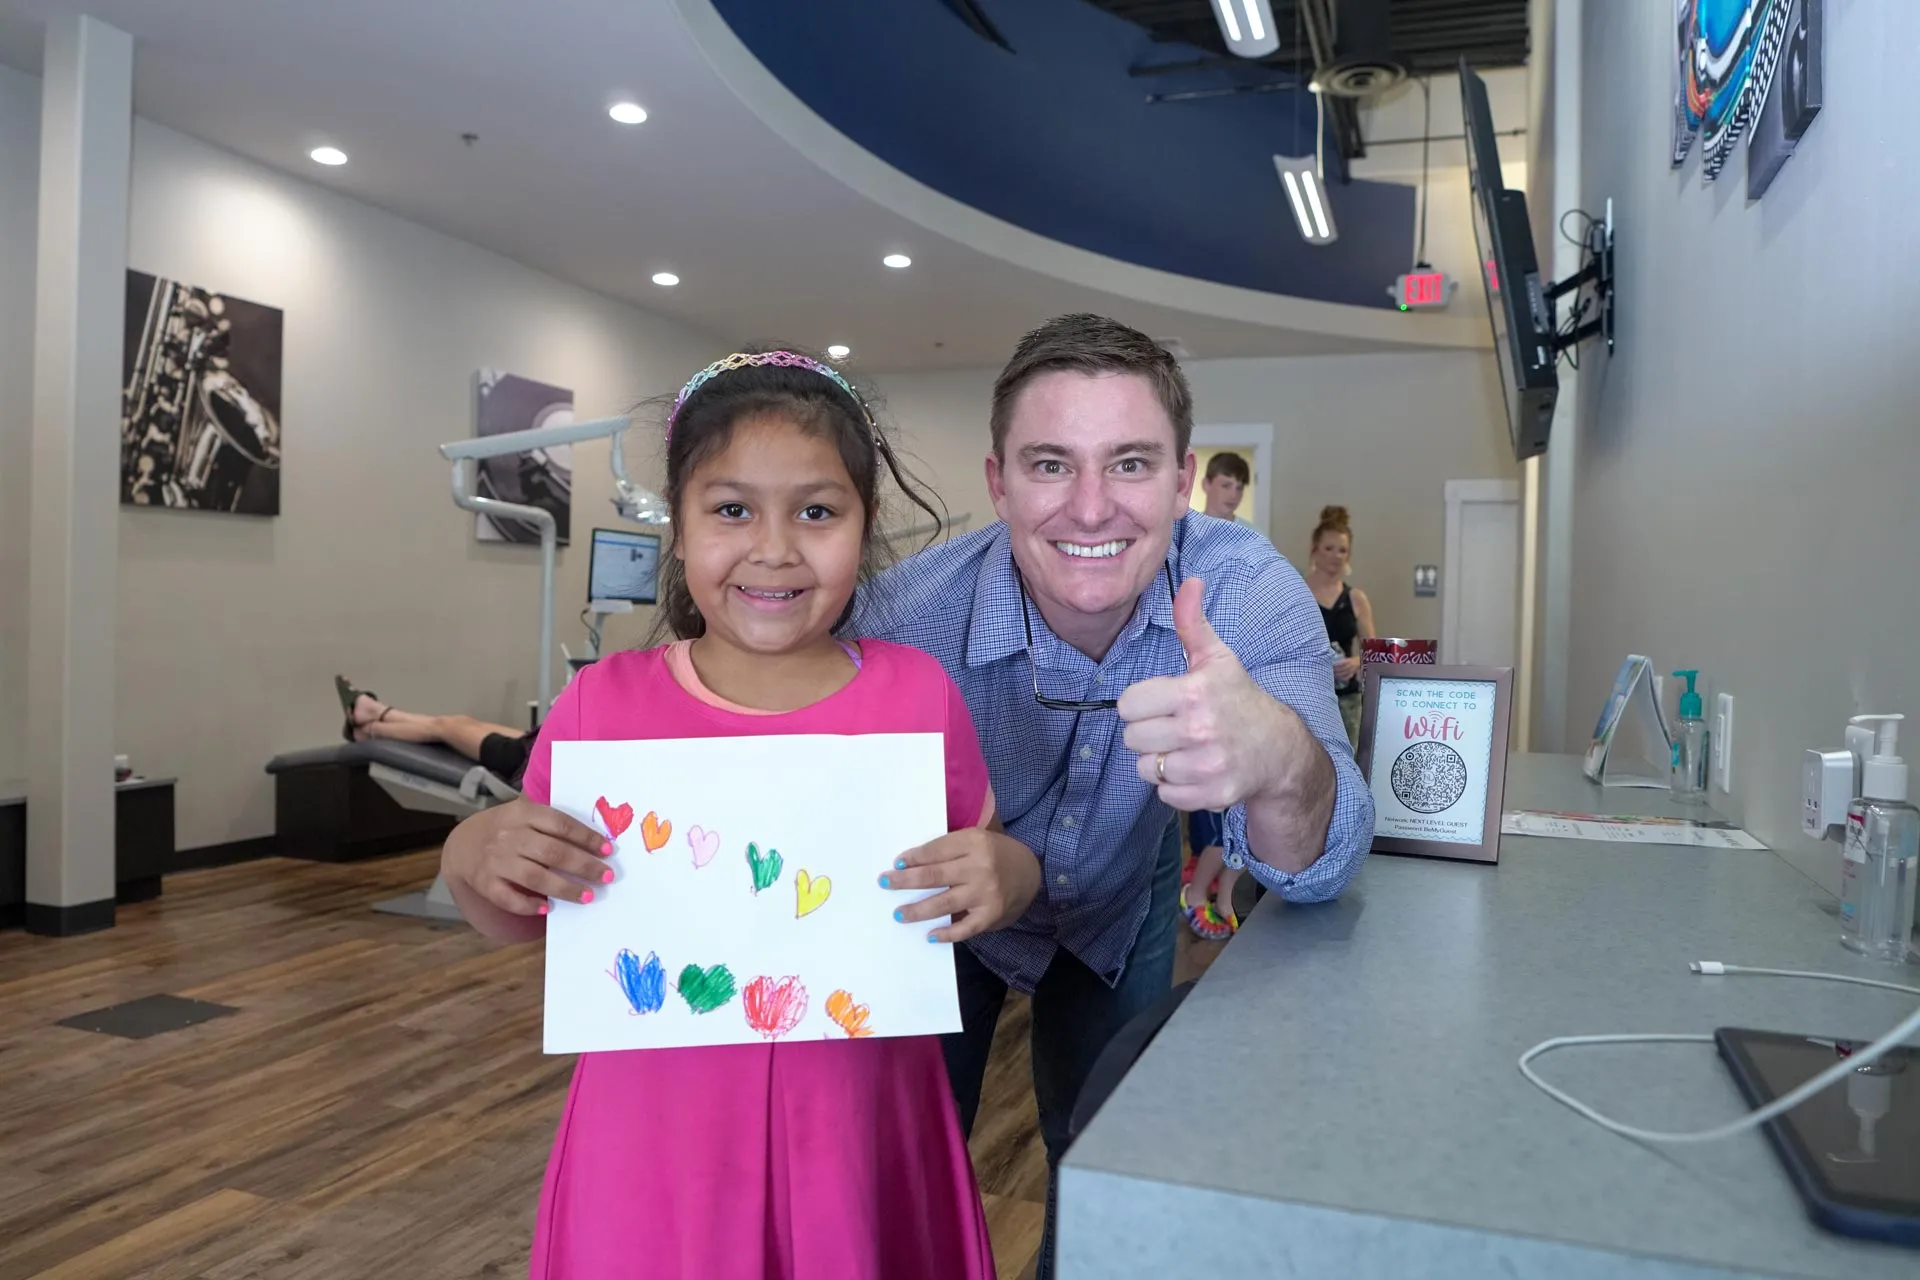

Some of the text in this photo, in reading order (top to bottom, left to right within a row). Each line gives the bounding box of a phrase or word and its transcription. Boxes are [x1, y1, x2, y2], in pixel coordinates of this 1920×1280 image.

[1405, 273, 1443, 304] EXIT
[1396, 689, 1476, 699] SCAN THE CODE
[1395, 700, 1477, 710] TO CONNECT TO
